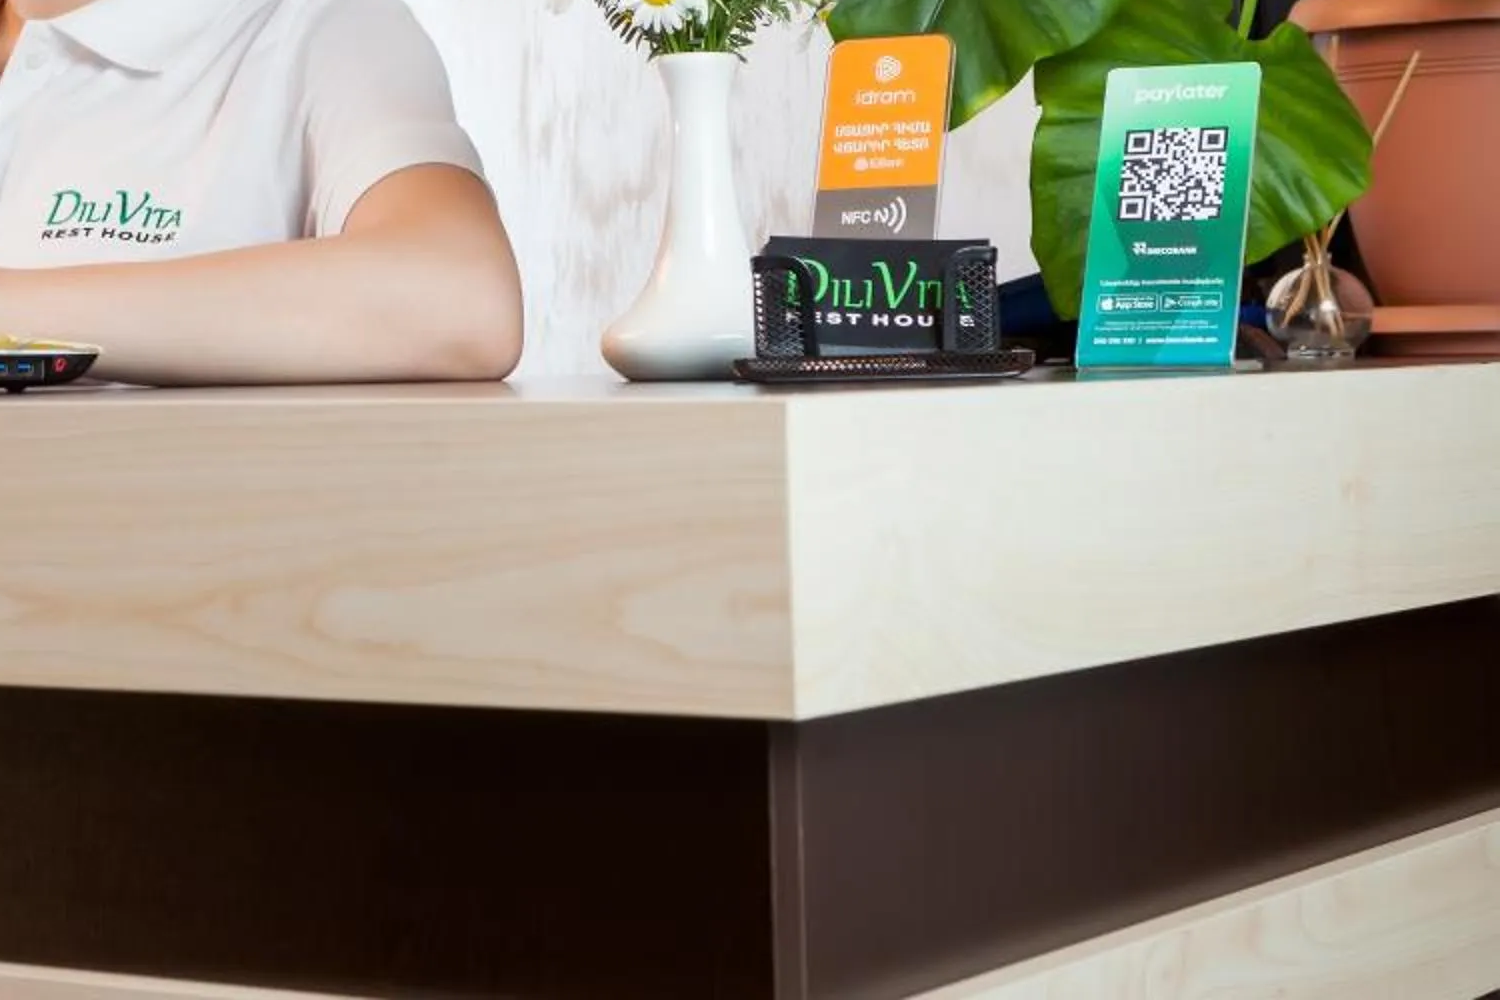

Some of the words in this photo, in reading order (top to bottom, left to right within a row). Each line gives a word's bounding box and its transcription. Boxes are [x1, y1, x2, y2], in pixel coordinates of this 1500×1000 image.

[1134, 83, 1229, 105] paylater
[841, 210, 871, 225] NFC
[41, 227, 94, 240] REST
[101, 227, 177, 243] HOUSE
[872, 312, 975, 327] HOUE
